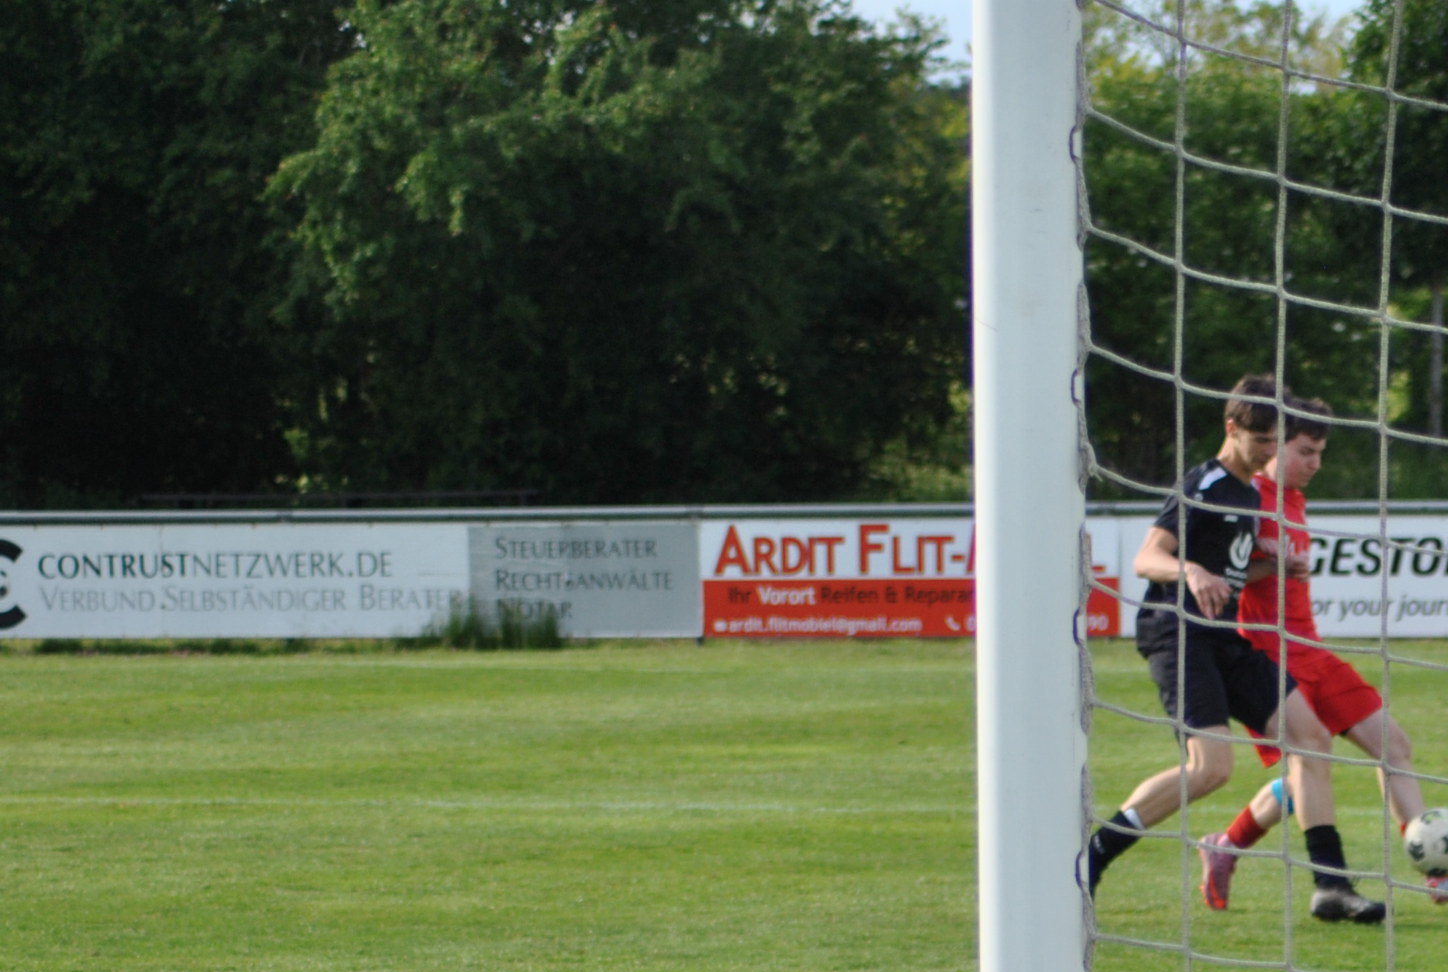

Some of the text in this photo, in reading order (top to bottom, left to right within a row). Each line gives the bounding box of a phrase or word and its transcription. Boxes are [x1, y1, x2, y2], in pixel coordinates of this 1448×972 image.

[714, 523, 976, 575] ARDIT FLIT-
[40, 585, 156, 612] VERBUND
[757, 586, 817, 605] Vorort
[904, 586, 976, 609] Repara
[1337, 599, 1393, 623] your
